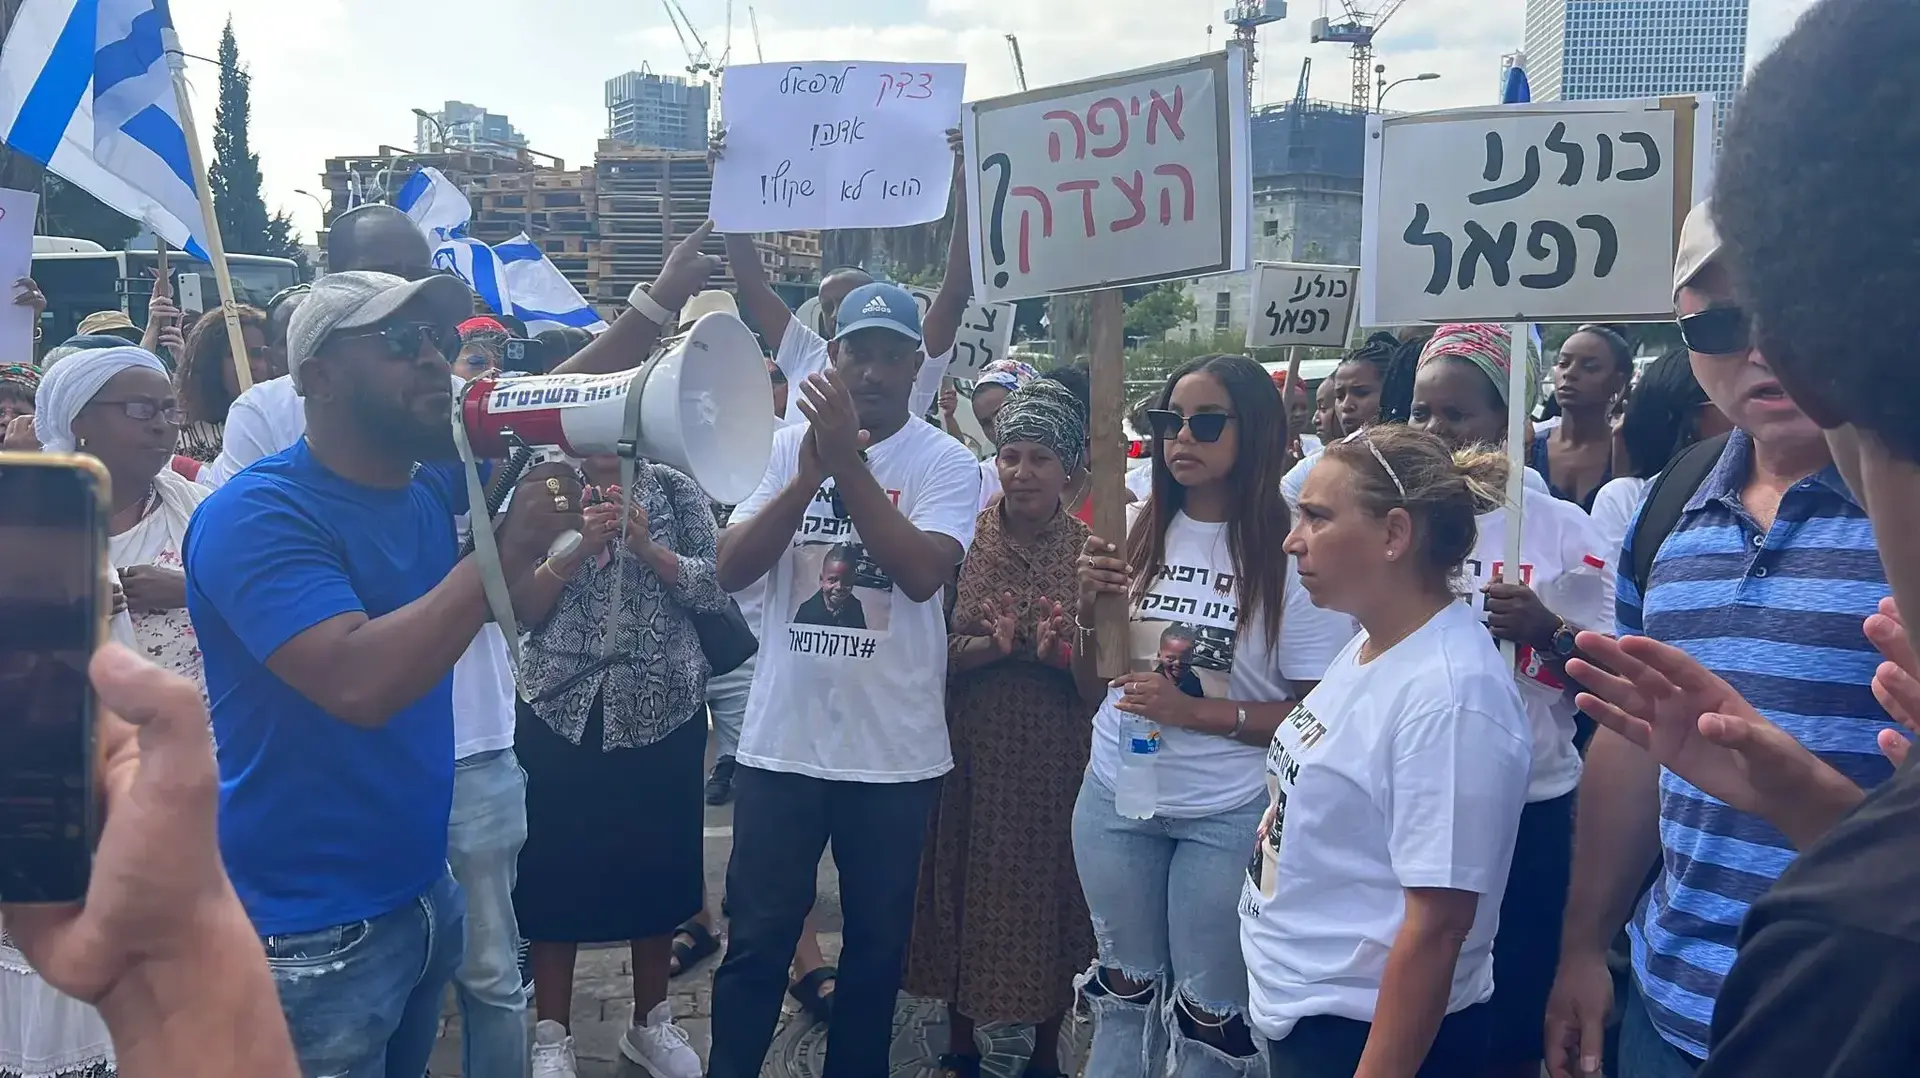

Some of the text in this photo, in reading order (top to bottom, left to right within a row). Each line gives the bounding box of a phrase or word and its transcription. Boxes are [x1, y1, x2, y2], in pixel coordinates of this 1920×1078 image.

[780, 66, 933, 107] צדק לרפאל
[1042, 84, 1186, 163] איפה
[1467, 121, 1661, 205] כולנו
[760, 159, 923, 208] הוא לא שקוף!
[1403, 202, 1618, 296] רפאל
[1288, 274, 1348, 304] כולנו
[862, 306, 892, 315] adidas
[1265, 301, 1330, 336] רפאל
[495, 388, 579, 408] משפטית
[1158, 564, 1210, 586] רפא
[788, 628, 876, 658] #צדקלרפאל
